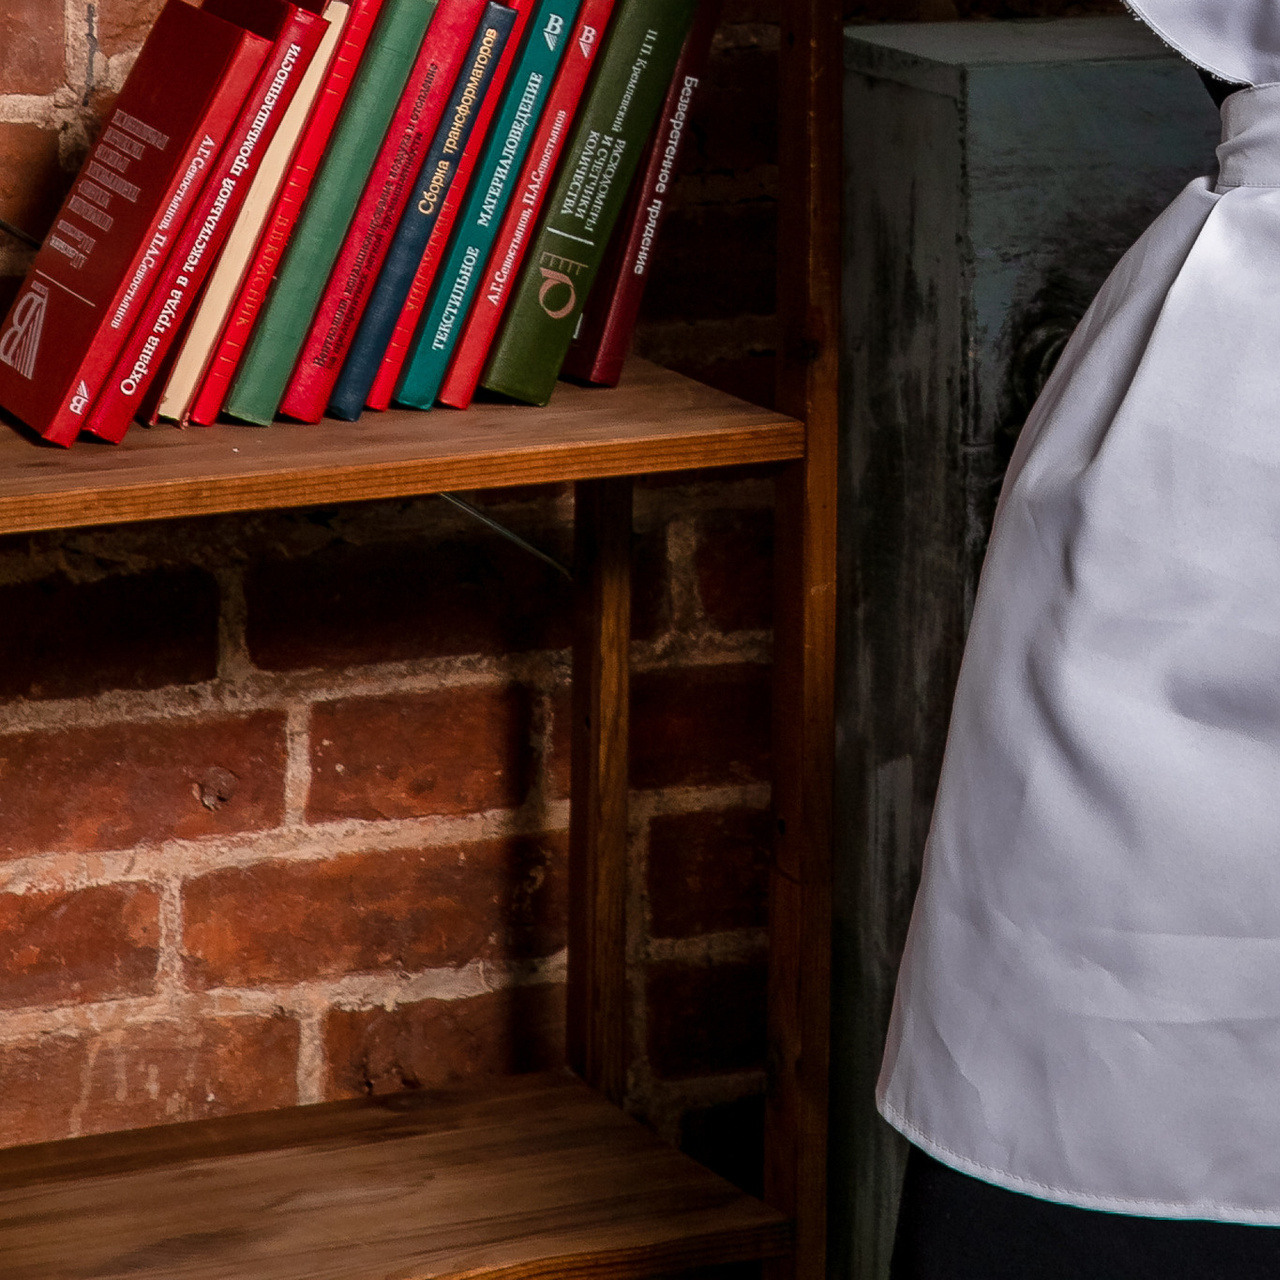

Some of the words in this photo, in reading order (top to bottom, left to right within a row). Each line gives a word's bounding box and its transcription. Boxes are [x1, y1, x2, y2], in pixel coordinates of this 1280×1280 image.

[229, 42, 301, 176] промышленности
[417, 159, 450, 214] Сборка
[442, 27, 497, 153] трансформаторов
[600, 134, 613, 146] И
[654, 75, 699, 193] Безверетенное
[431, 245, 479, 350] ТЕКСТИЛЬНОЕ
[476, 71, 543, 227] МАТЕРИАЛОВЕДЕНИЕ
[560, 129, 600, 216] КОЛИЧЕСТВА
[573, 147, 608, 221] СЧЕТЧИКИ
[583, 136, 626, 232] РАСХОДОМЕРЫ
[181, 176, 236, 272] текстильной
[633, 198, 662, 274] прядение
[152, 288, 183, 333] труда
[175, 275, 188, 287] в
[119, 335, 160, 395] Охрана
